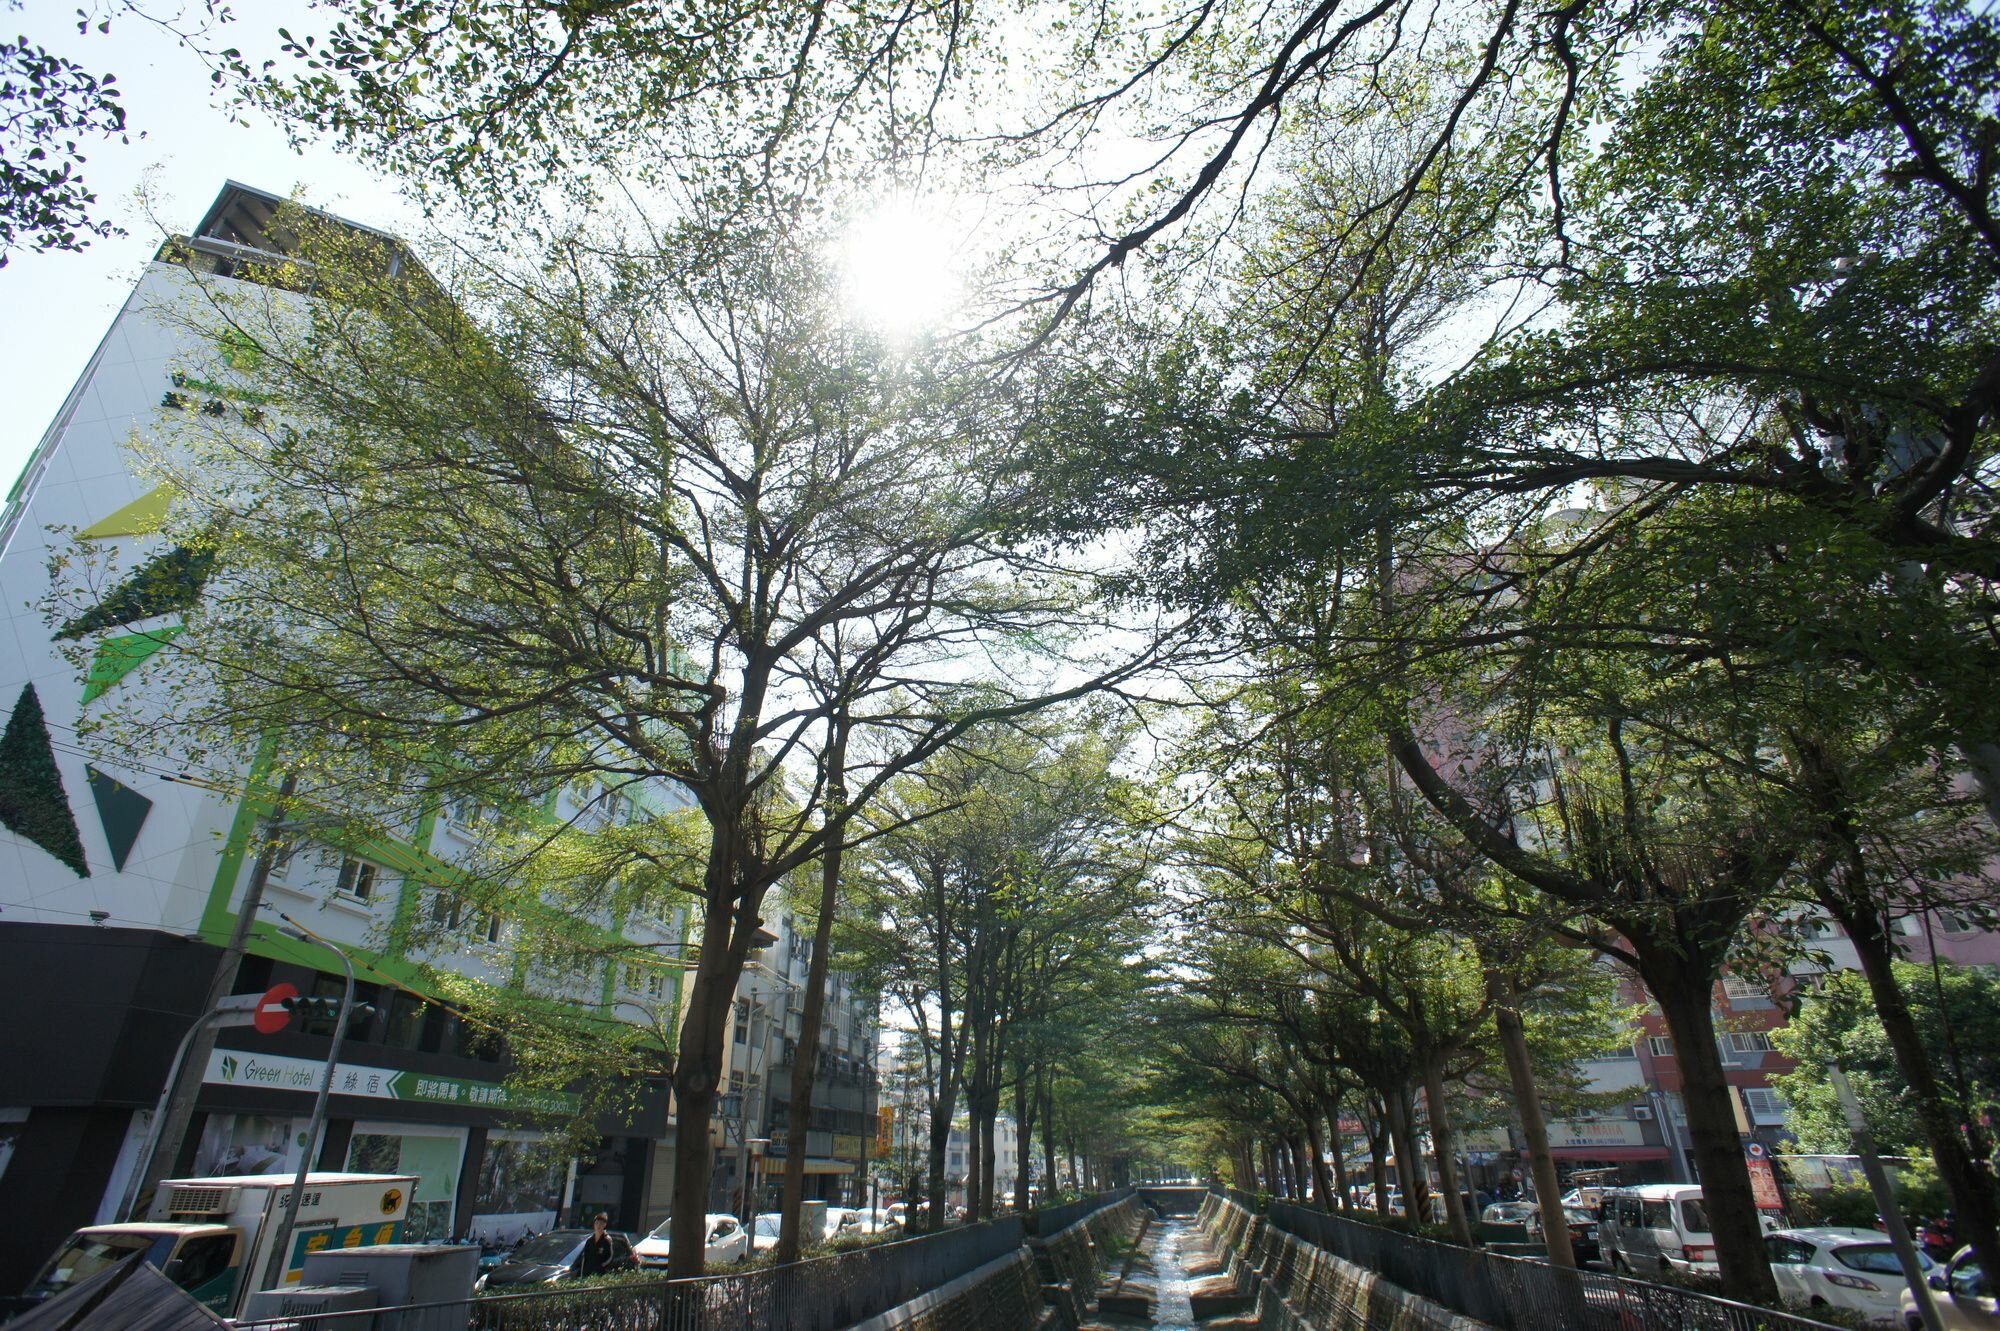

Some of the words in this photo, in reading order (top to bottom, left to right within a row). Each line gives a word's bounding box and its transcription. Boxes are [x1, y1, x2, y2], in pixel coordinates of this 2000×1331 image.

[244, 1059, 281, 1083] Green
[284, 1064, 315, 1087] Hotel
[278, 1192, 322, 1208] 統速達
